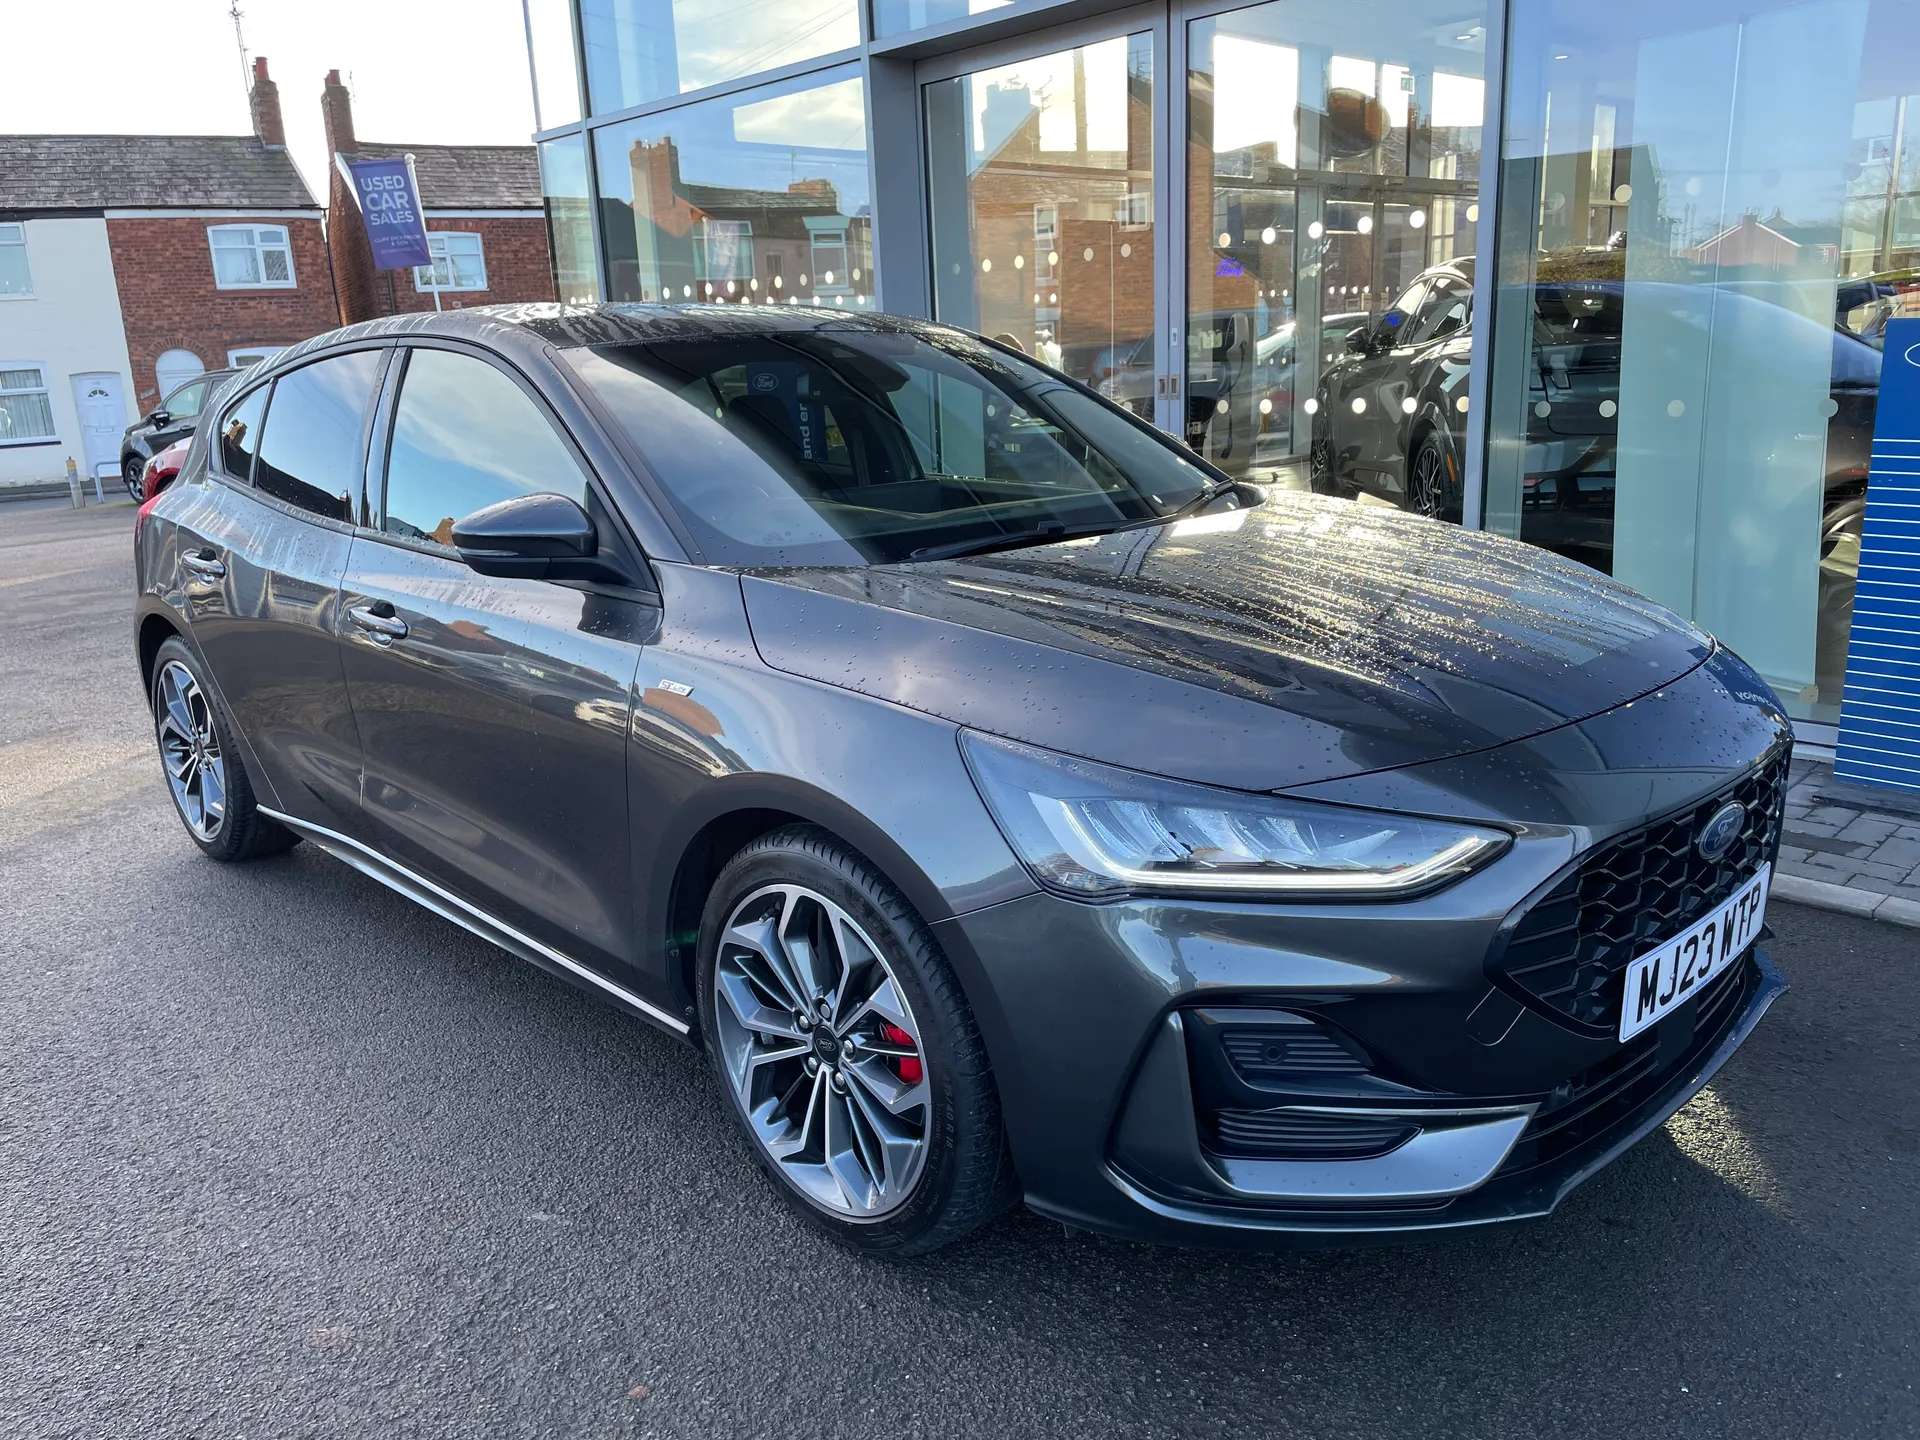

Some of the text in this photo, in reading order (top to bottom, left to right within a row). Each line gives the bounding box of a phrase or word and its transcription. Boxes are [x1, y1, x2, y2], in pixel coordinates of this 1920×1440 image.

[360, 175, 405, 191] USED
[366, 191, 409, 211] CAR
[370, 211, 415, 226] SALES
[1635, 881, 1762, 1024] MJ23 WTP
